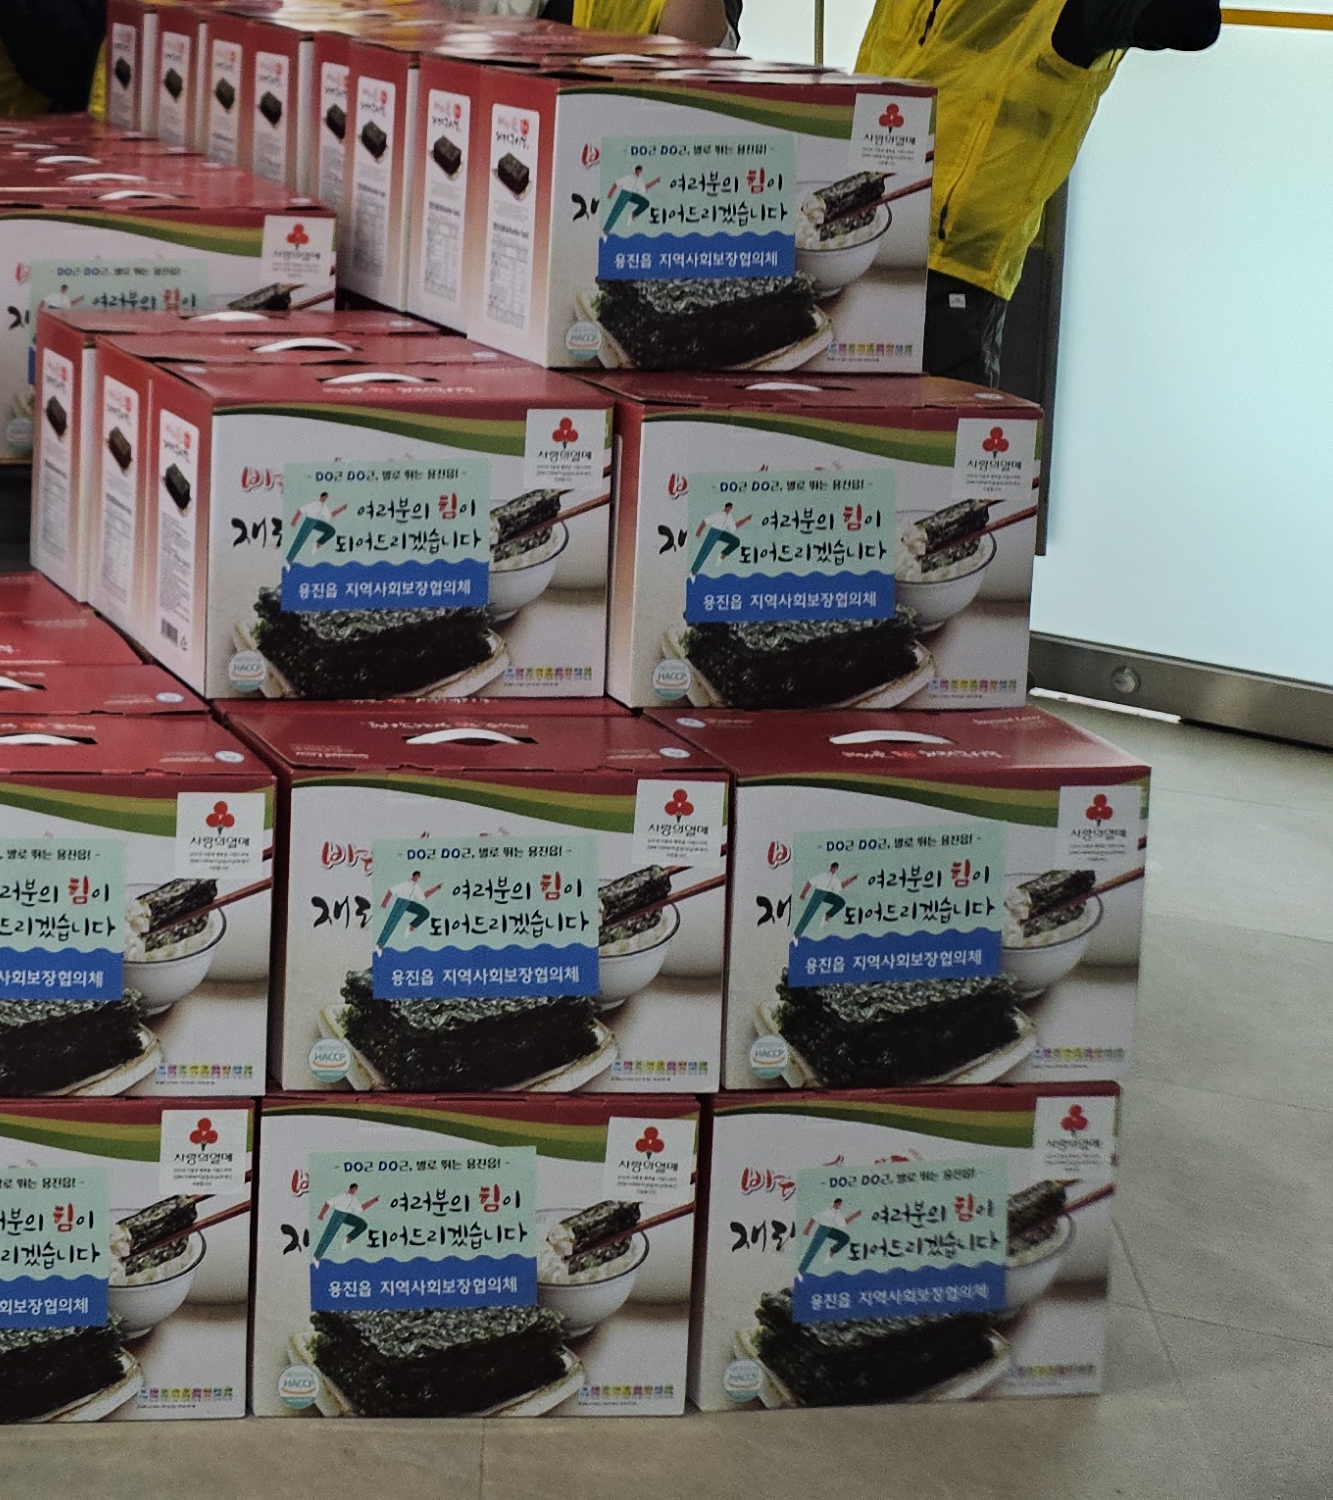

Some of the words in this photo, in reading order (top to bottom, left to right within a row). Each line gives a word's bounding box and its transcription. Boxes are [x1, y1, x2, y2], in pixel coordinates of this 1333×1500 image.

[670, 171, 739, 196] 여러분의
[746, 167, 782, 193] 힘이
[648, 201, 788, 227] 되어드리겠습니다
[614, 253, 652, 269] 용진읍
[658, 251, 777, 268] 지역사회보장협의체
[357, 497, 429, 523] 여러분의
[438, 492, 475, 520] 힘이
[761, 508, 834, 534] 여러분의
[843, 503, 881, 531] 힘이
[334, 527, 482, 555] 되어드리겠습니다
[739, 539, 887, 566] 되어드리겠습니다
[298, 583, 338, 599] 용진읍
[345, 579, 470, 598] 지역사회보장협의체
[703, 594, 743, 611] 용진읍
[749, 591, 876, 610] 지역사회보장협의체
[68, 875, 110, 905] 힘이
[452, 876, 532, 904] 여러분의
[540, 871, 582, 900] 힘이
[867, 864, 942, 894] 여러분의
[950, 858, 990, 887] 힘이
[428, 909, 590, 938] 되어드리겠습니다
[843, 894, 995, 927] 되어드리겠습니다
[804, 956, 845, 974] 용진읍
[852, 949, 981, 972] 지역사회보장협의체
[391, 969, 434, 987] 용진읍
[441, 966, 579, 985] 지역사회보장협의체
[390, 1188, 470, 1217] 여러분의
[478, 1183, 521, 1212] 힘이
[871, 1199, 946, 1229] 여러분의
[954, 1192, 993, 1222] 힘이
[53, 1203, 94, 1232] 힘이
[365, 1221, 529, 1250] 되어드리겠습니다
[848, 1229, 1000, 1263] 되어드리겠습니다
[328, 1281, 372, 1298] 용진읍
[379, 1277, 517, 1297] 지역사회보장협의체
[810, 1292, 851, 1311] 용진읍
[858, 1283, 988, 1307] 지역사회보장협의체
